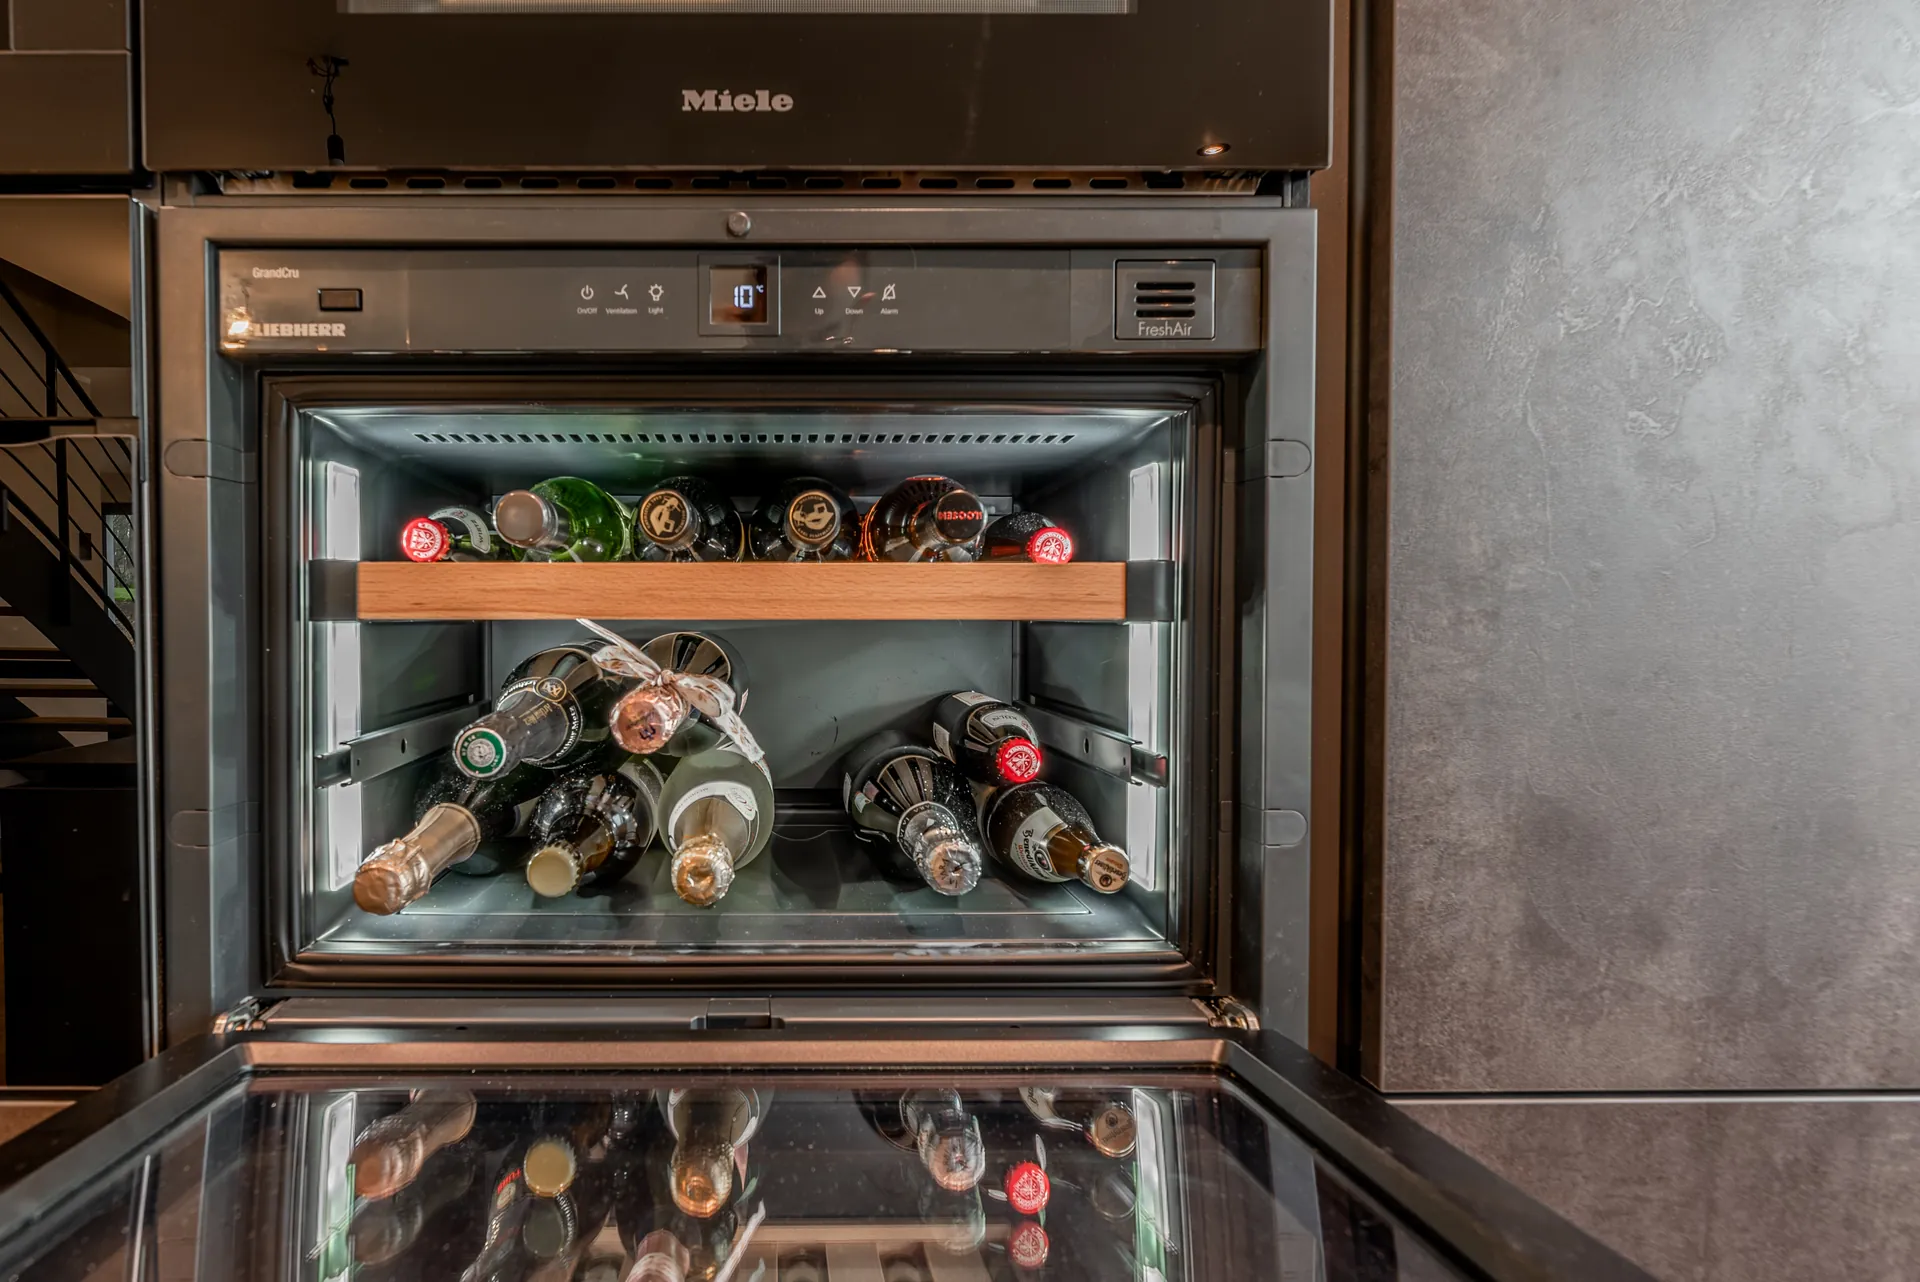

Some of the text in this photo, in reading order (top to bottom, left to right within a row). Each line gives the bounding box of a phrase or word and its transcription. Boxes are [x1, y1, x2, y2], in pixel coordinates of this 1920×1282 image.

[682, 89, 794, 112] Miele
[252, 267, 299, 278] GrandCru
[734, 284, 753, 308] 10
[605, 307, 638, 315] Ventilation
[647, 307, 664, 315] Light
[814, 307, 824, 316] Up
[845, 307, 864, 315] Down
[880, 307, 899, 315] Alarm
[253, 323, 346, 337] LIEBHERR
[1138, 321, 1193, 337] FreshAir
